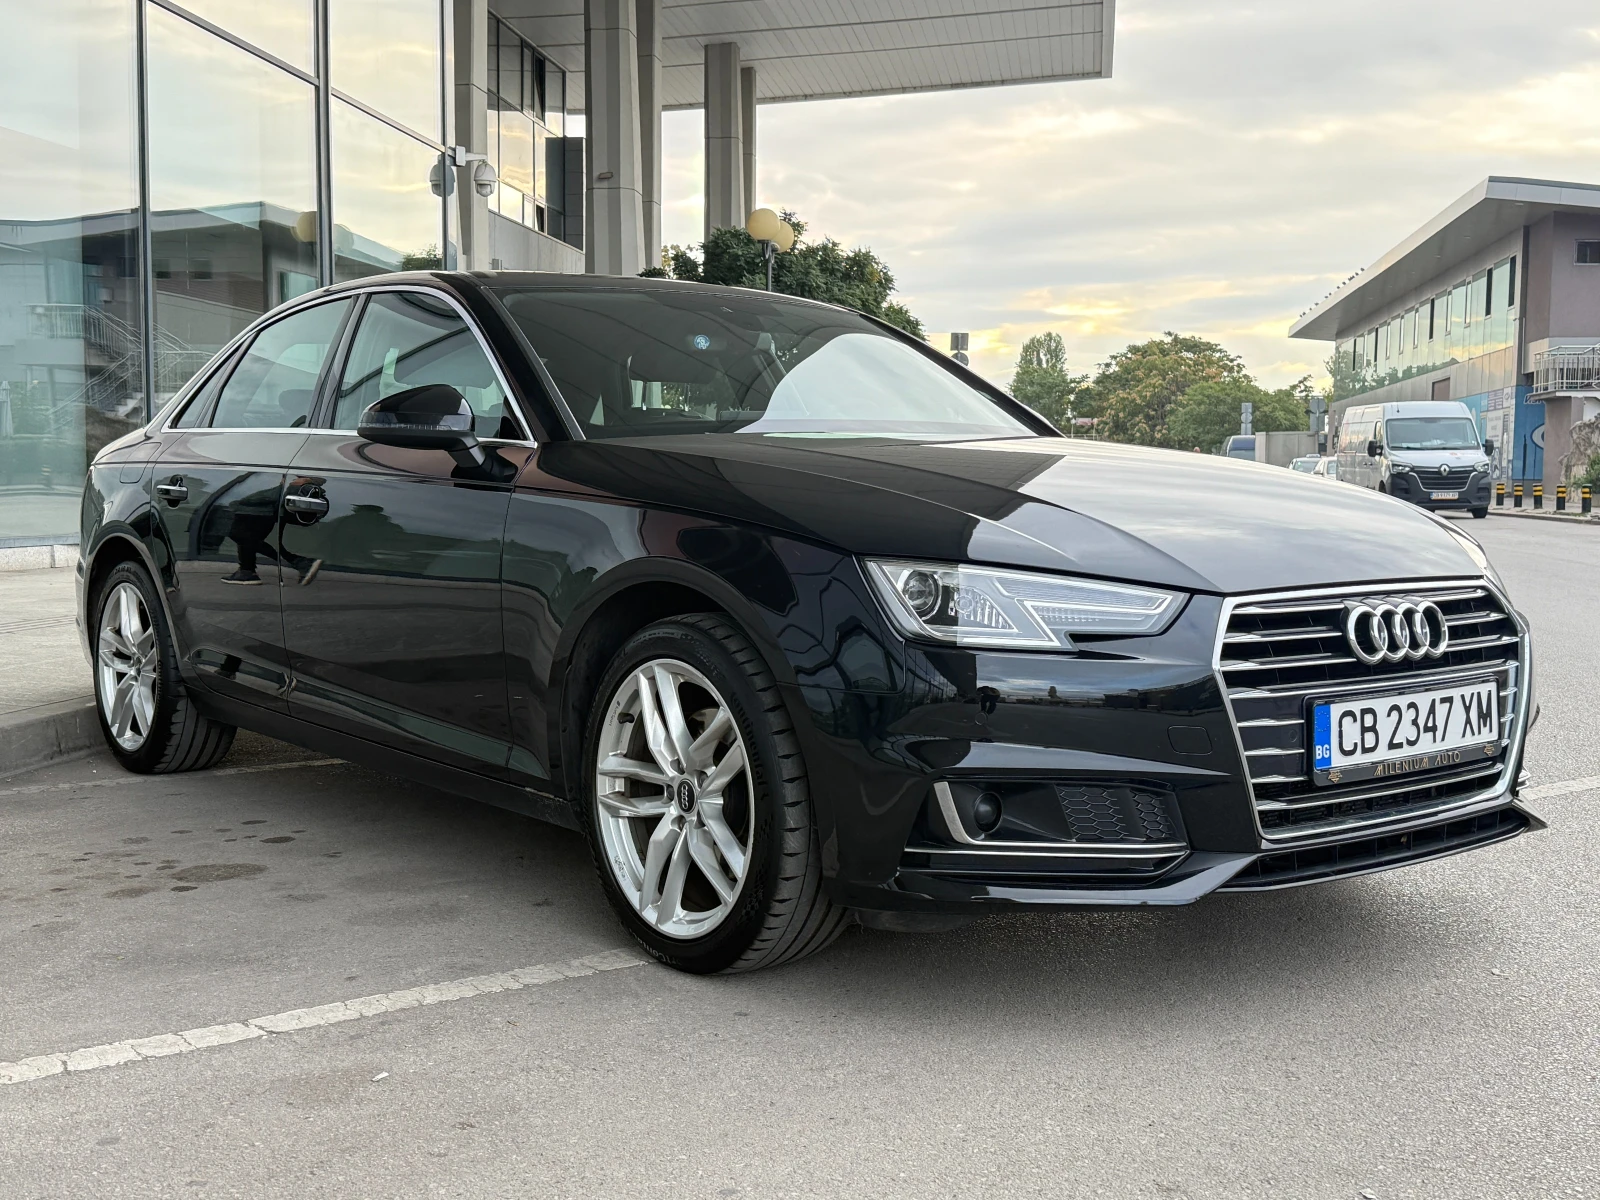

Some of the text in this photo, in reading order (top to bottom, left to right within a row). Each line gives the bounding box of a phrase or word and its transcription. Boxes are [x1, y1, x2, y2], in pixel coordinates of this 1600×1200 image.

[1338, 689, 1493, 757] CB 2347 XM
[1315, 744, 1330, 760] BG
[1374, 750, 1461, 776] MILENIUM AUTO
